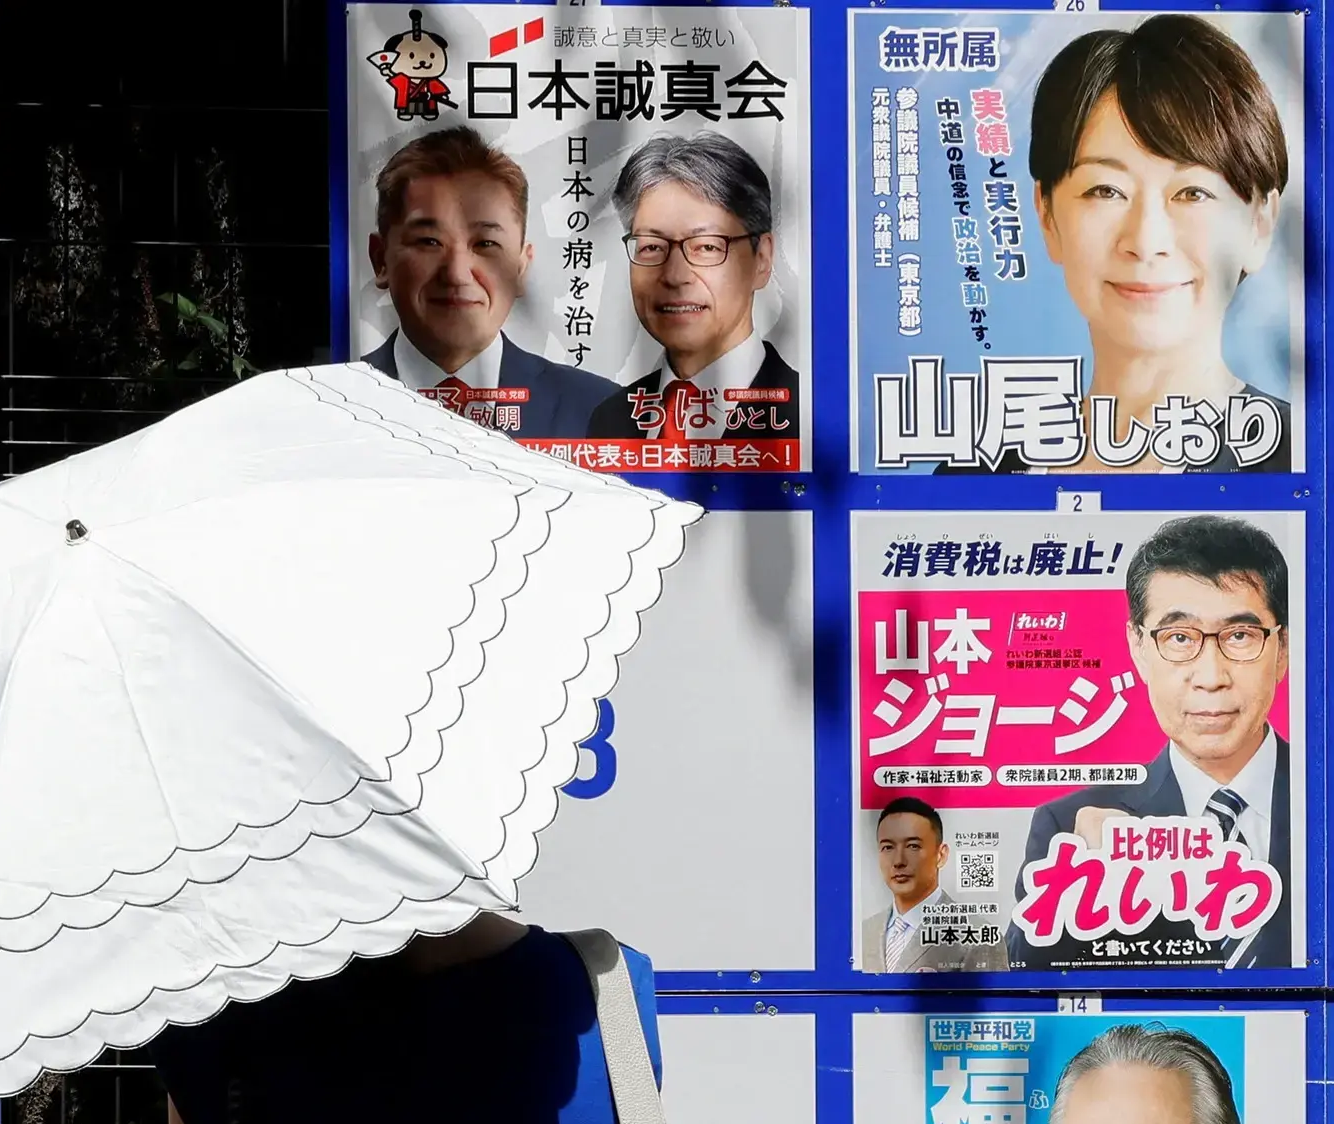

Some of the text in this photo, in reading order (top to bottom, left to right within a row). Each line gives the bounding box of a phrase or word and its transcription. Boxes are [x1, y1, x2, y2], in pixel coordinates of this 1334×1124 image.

[553, 26, 735, 49] 誠意と真実と敬い
[882, 29, 998, 70] 無所属
[466, 59, 789, 122] 日本誠真会
[871, 87, 893, 268] 元衆議院議員・弁護士
[971, 88, 1027, 280] 実績と実行力
[935, 97, 992, 351] 中道の信念で政治を動かす。
[561, 136, 594, 368] 日本の病を治す
[628, 387, 790, 430] ちば ひとし
[1073, 495, 1082, 511] 2
[882, 540, 1124, 577] 消費税は廃止!
[1017, 612, 1058, 629] れいわ
[874, 608, 993, 675] 山本
[1007, 649, 1061, 658] れいわ新選組
[869, 671, 1136, 757] ジョージ
[883, 769, 983, 785] 作家・福祉活動家
[955, 832, 999, 840] れいわ新選組
[1110, 828, 1214, 860] 比例は
[1022, 843, 1273, 937] れいわ
[922, 904, 998, 914] れいわ新選組 代表
[923, 916, 968, 925] 参議院議員
[921, 926, 1000, 945] 山本太郎
[1092, 940, 1212, 956] と書いてください
[1070, 996, 1087, 1013] 14
[933, 1020, 1032, 1041] 世界平和党
[933, 1042, 1030, 1052] World Peace Party
